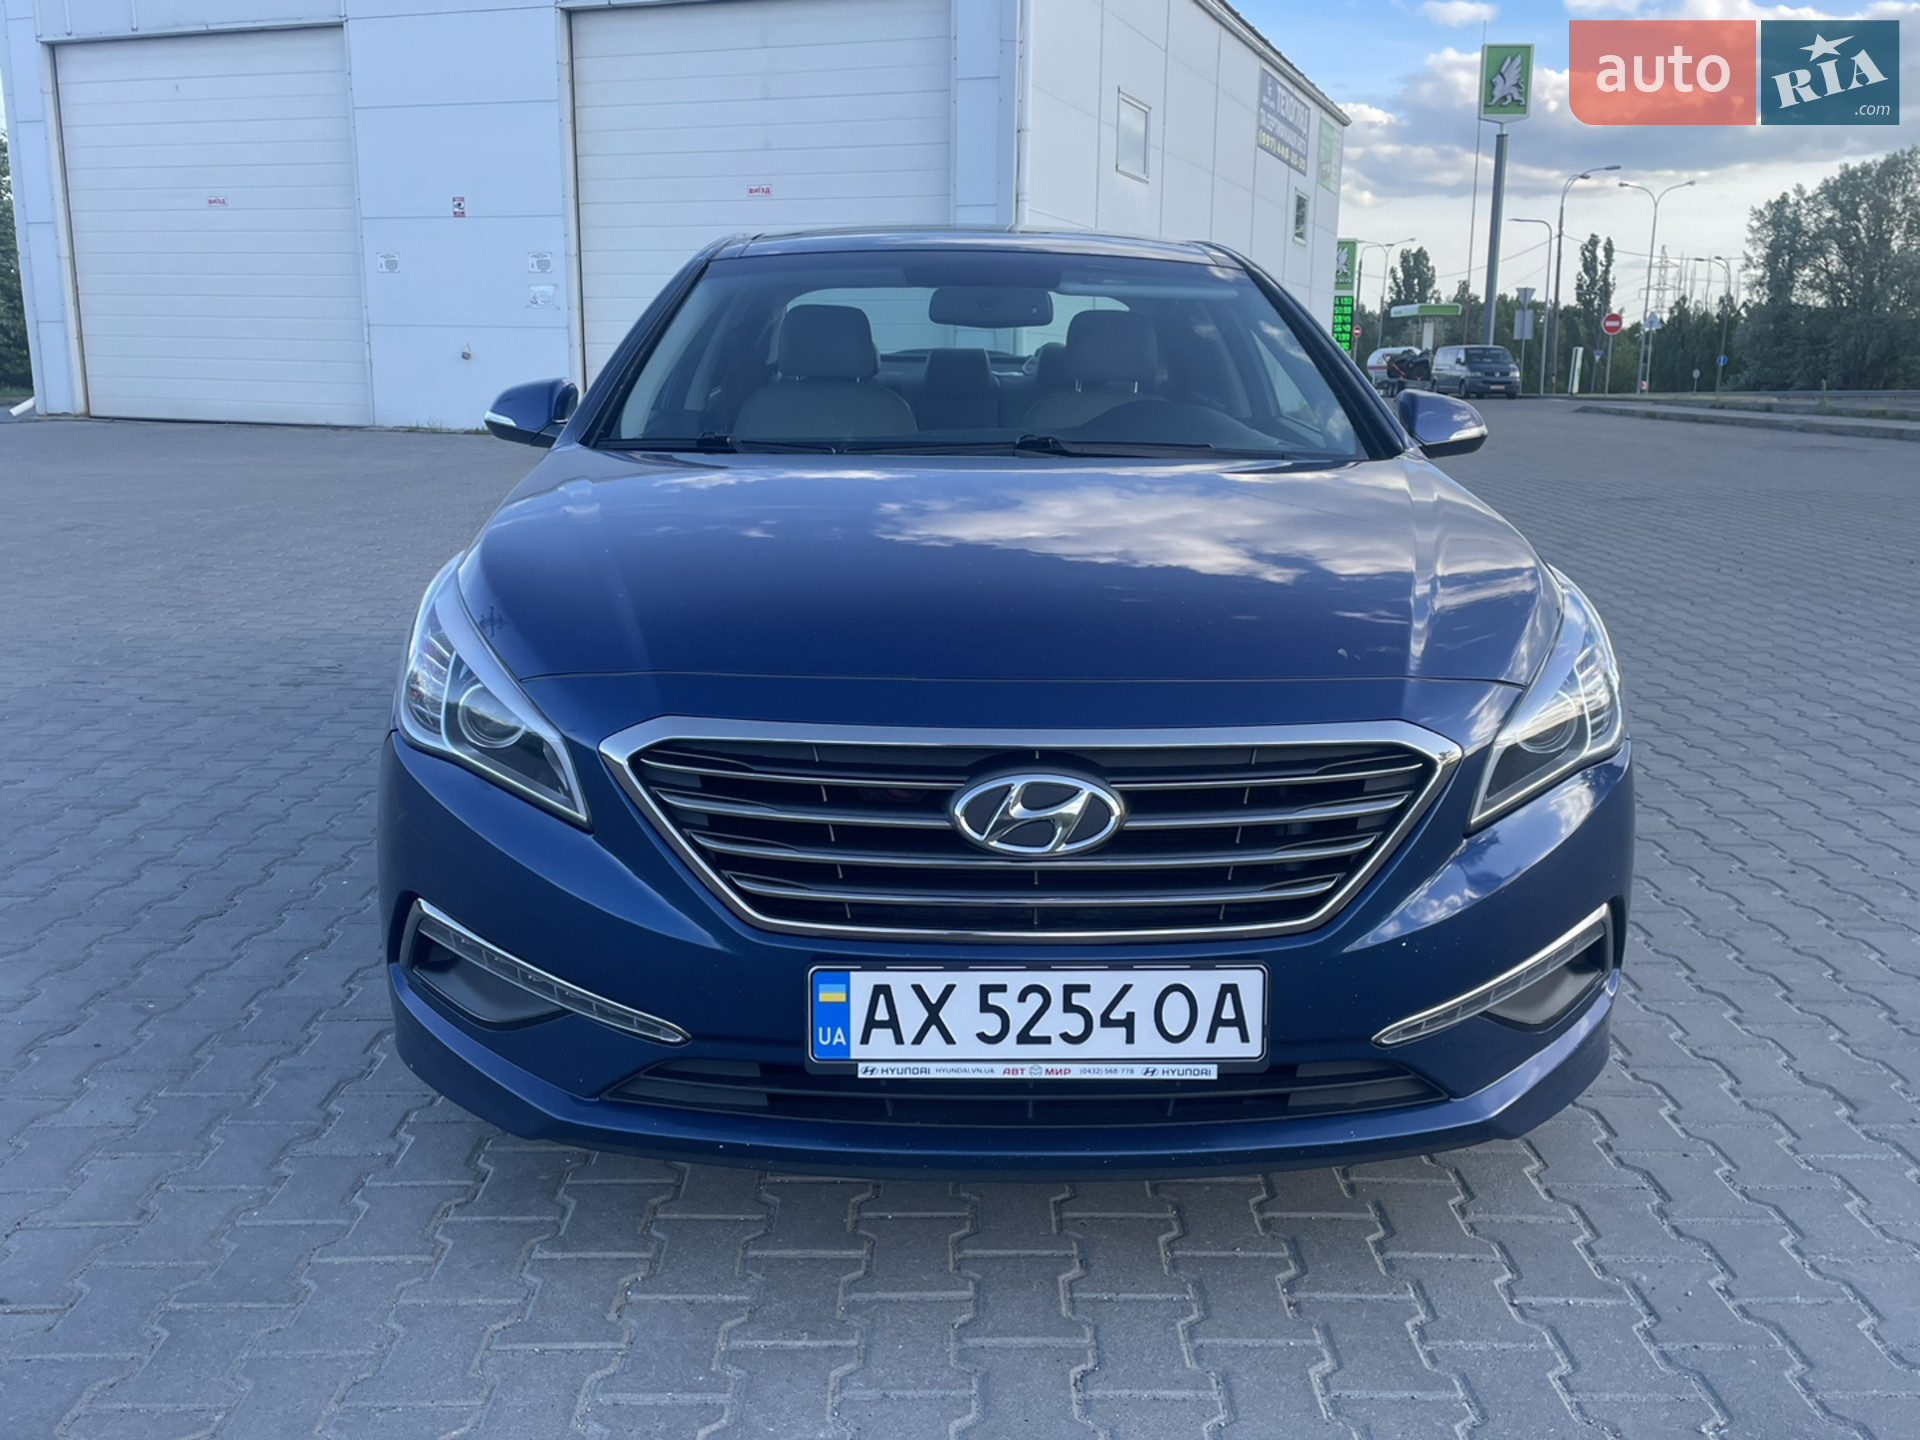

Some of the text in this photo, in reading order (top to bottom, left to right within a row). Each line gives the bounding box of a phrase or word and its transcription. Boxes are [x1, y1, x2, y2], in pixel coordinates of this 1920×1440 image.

[859, 983, 1250, 1045] AX 5254 OA
[818, 1026, 846, 1045] UA
[881, 1066, 930, 1075] HYUNDAI
[1045, 1068, 1071, 1076] МИР
[1162, 1068, 1211, 1077] HYUNDAI
